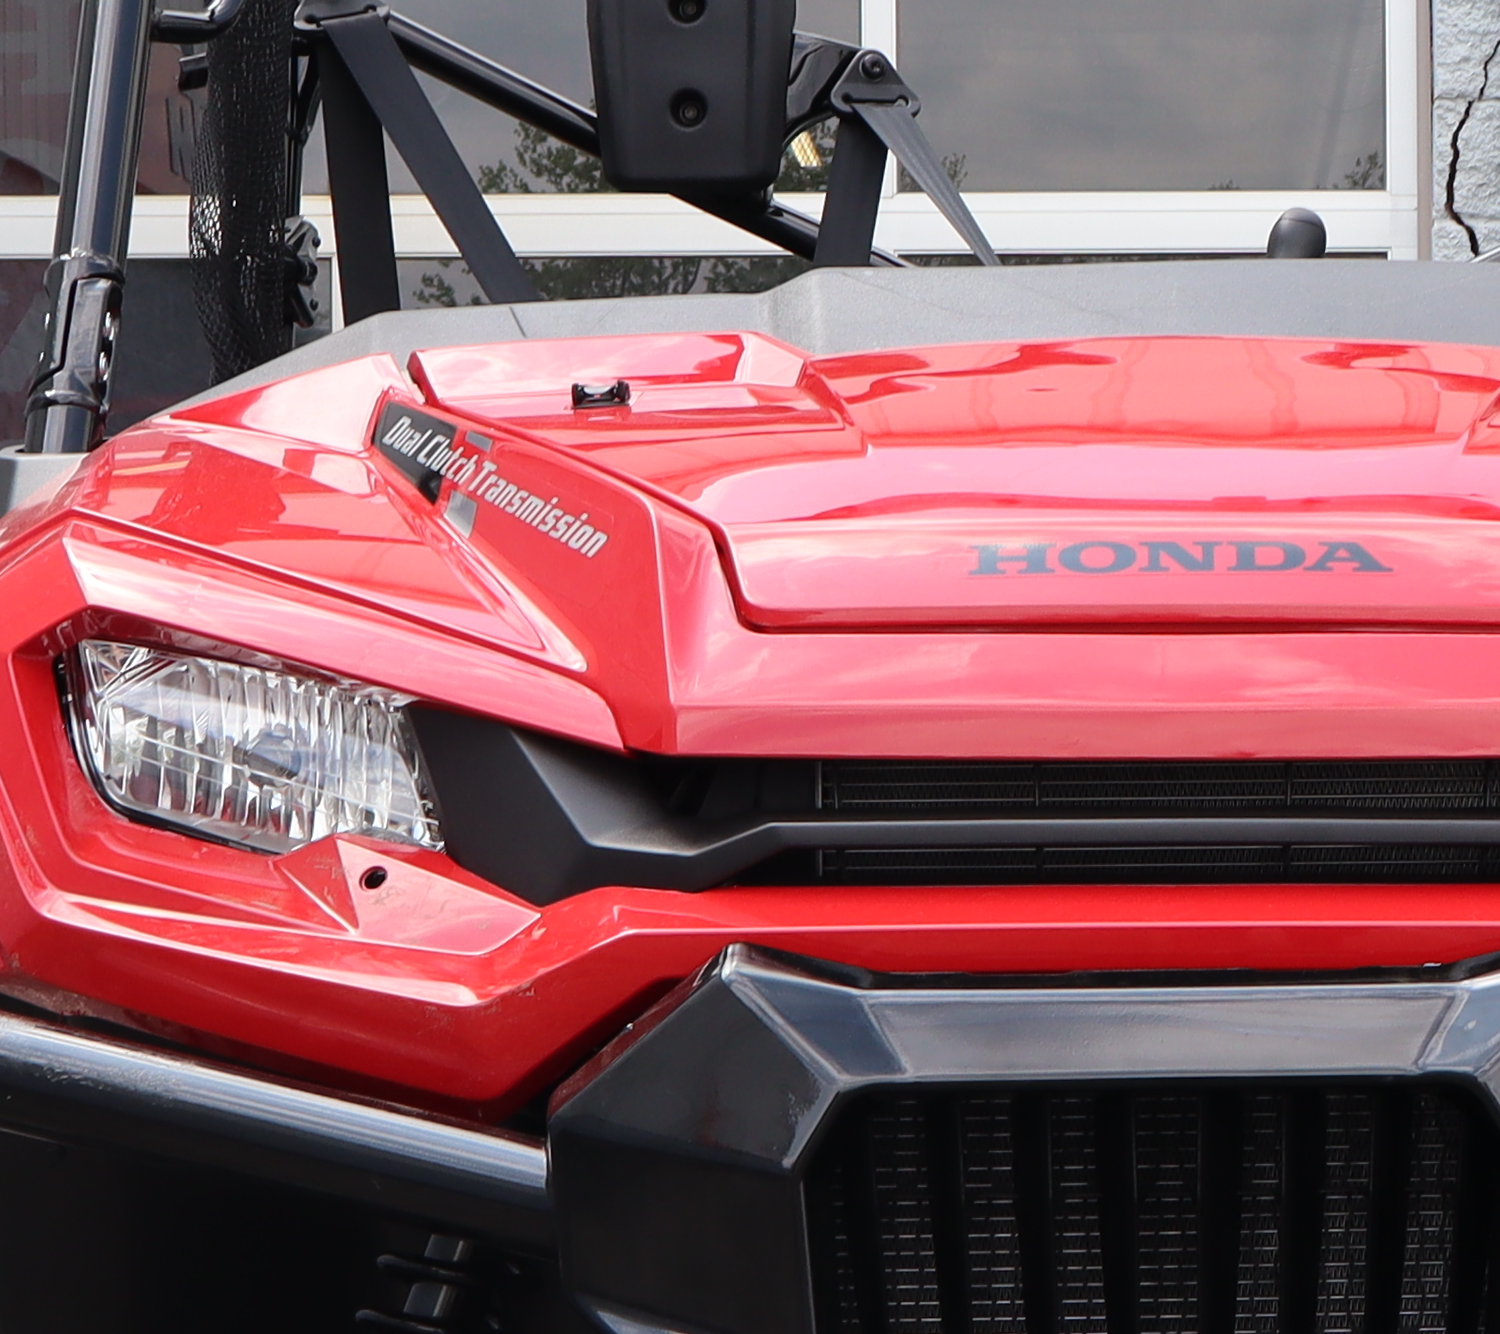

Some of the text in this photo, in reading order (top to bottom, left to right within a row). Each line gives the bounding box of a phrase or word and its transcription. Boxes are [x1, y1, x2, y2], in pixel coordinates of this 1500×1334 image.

[382, 416, 609, 559] Dual Clutch Transmission
[967, 540, 1395, 576] HONDA
